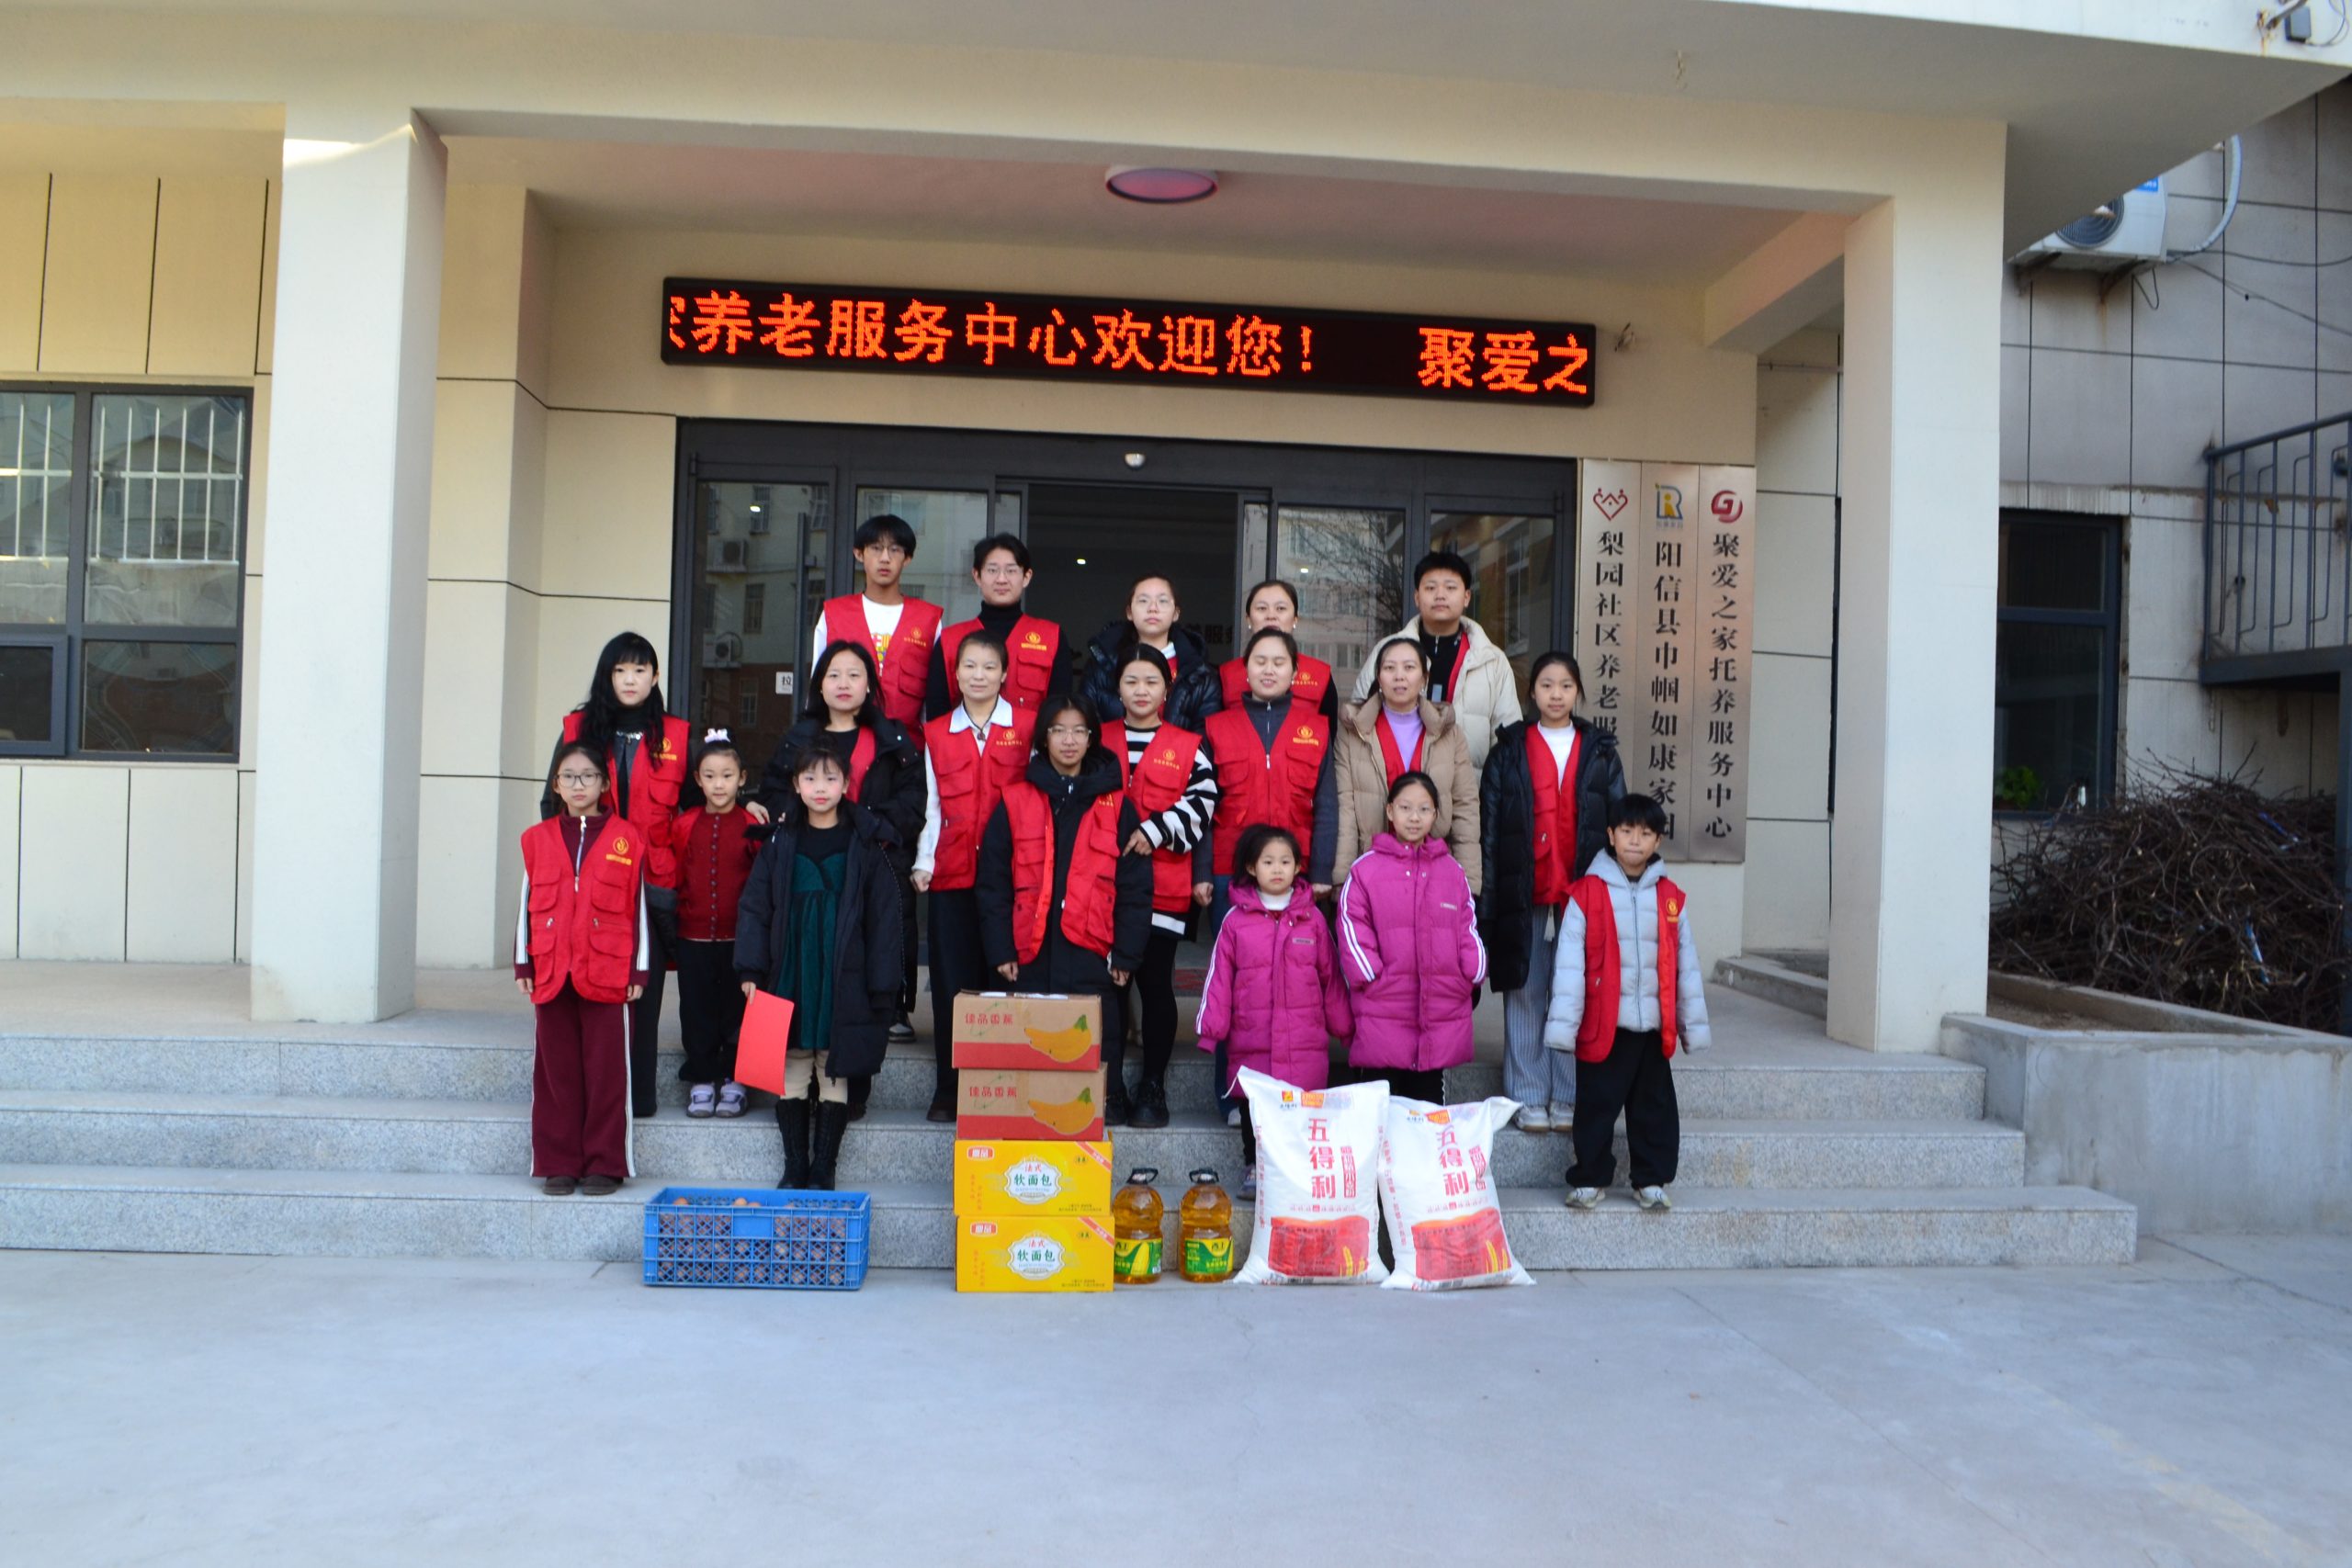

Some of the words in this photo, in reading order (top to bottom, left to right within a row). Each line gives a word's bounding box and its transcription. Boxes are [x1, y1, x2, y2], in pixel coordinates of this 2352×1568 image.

[1419, 327, 1588, 394] 聚爱之
[1705, 532, 1739, 839] 聚爱之家托养服务中心
[1014, 1173, 1053, 1187] 软面包
[1308, 1117, 1337, 1199] 五得利
[1017, 1248, 1056, 1262] 软面包
